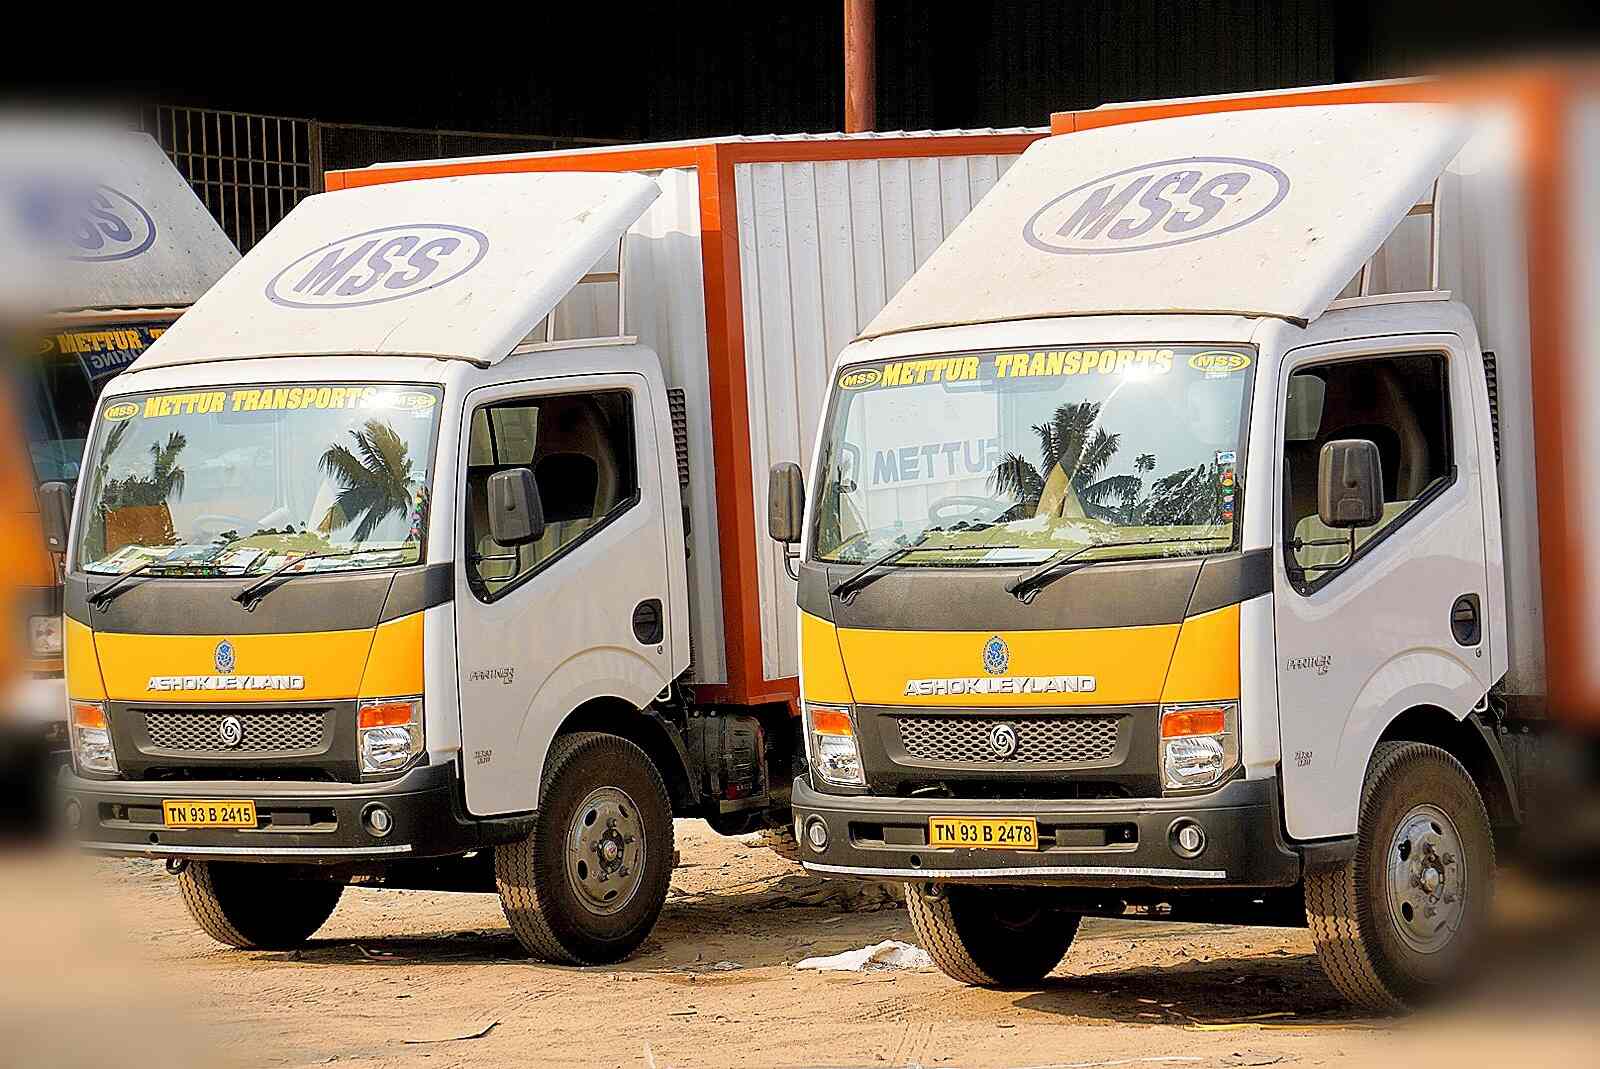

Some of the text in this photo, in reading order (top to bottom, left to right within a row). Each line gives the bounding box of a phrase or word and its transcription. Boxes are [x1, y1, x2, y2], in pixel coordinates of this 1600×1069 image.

[1056, 170, 1251, 240] MSS
[292, 235, 462, 297] MSS
[57, 330, 143, 353] METTUR
[881, 349, 1175, 388] METTUR TRANSPORTS
[143, 391, 227, 418] METTUR
[146, 675, 305, 691] ASHOK LEYLAND
[903, 676, 1098, 696] ASHOK LEYLAND
[168, 806, 251, 822] TN 93 B 2415
[934, 825, 1033, 843] TN 93 B 2478
